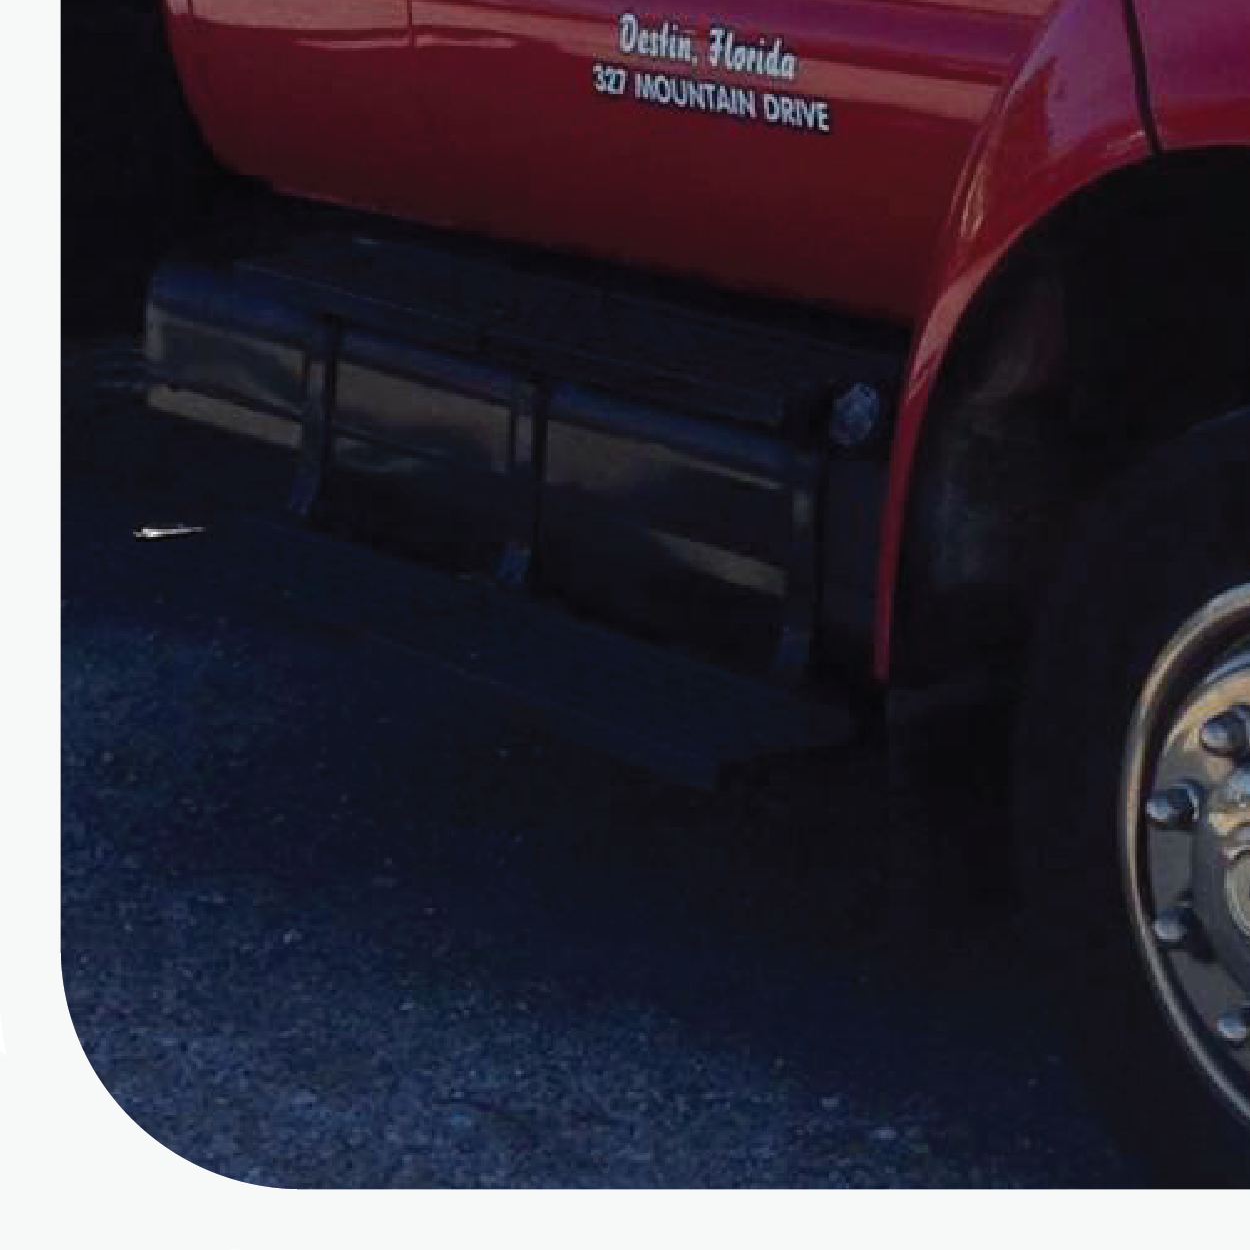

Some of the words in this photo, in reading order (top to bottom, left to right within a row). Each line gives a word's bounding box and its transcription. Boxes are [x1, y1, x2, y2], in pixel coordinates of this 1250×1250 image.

[708, 27, 797, 81] Florida
[593, 63, 627, 95] 327
[633, 73, 756, 119] MOUNTAIN
[762, 94, 830, 133] DRIVE
